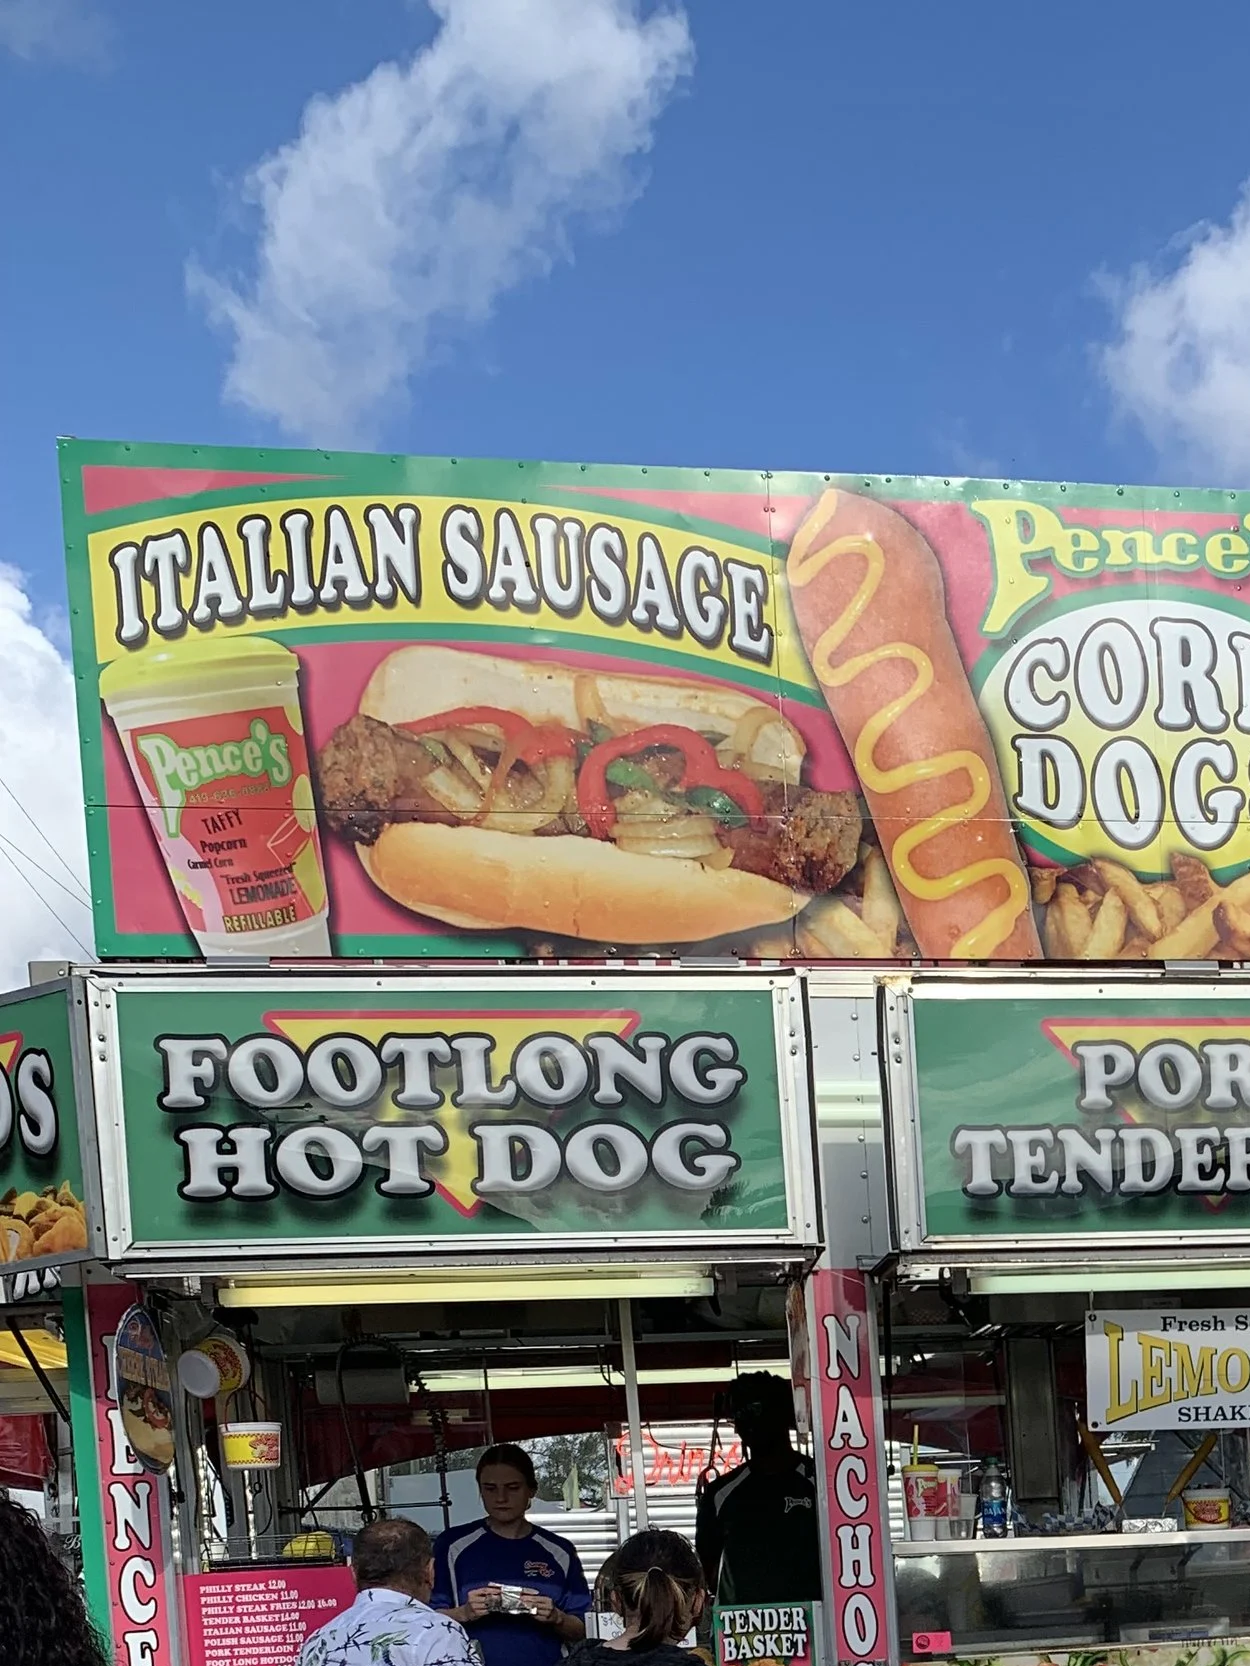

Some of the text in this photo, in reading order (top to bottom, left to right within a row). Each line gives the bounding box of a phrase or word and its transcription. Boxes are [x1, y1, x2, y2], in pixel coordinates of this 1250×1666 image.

[111, 504, 774, 661] ITALIAN SAUSAGE
[137, 718, 293, 838] Pence's
[201, 809, 244, 835] TAFFY
[200, 838, 247, 854] Popcorn
[214, 857, 234, 869] Corn
[229, 877, 297, 906] LEMONADE
[222, 903, 296, 933] REFILLABLE
[155, 1031, 746, 1114] FOOTLONG
[174, 1119, 741, 1200] HOT DOG
[1161, 1315, 1225, 1332] Fresh
[200, 1585, 233, 1594] PHILLY
[234, 1583, 266, 1592] STEAK
[200, 1595, 234, 1604] PHILLY
[235, 1593, 279, 1602] CHICKEN
[202, 1606, 235, 1615] PHILLY
[236, 1604, 268, 1614] STEAK
[270, 1602, 297, 1611] FRIES
[202, 1616, 241, 1626] TENDER
[242, 1614, 280, 1624] BASKET
[719, 1607, 807, 1635] TENDER
[203, 1627, 243, 1636] ITALIAN
[244, 1624, 288, 1634] SAUSAGE
[204, 1637, 239, 1647] POLISH
[240, 1635, 284, 1645] SAUSAGE
[723, 1633, 807, 1662] BASKET
[205, 1648, 232, 1657] PORK
[233, 1645, 294, 1656] TENDERLOIN
[233, 1657, 259, 1666] LONG
